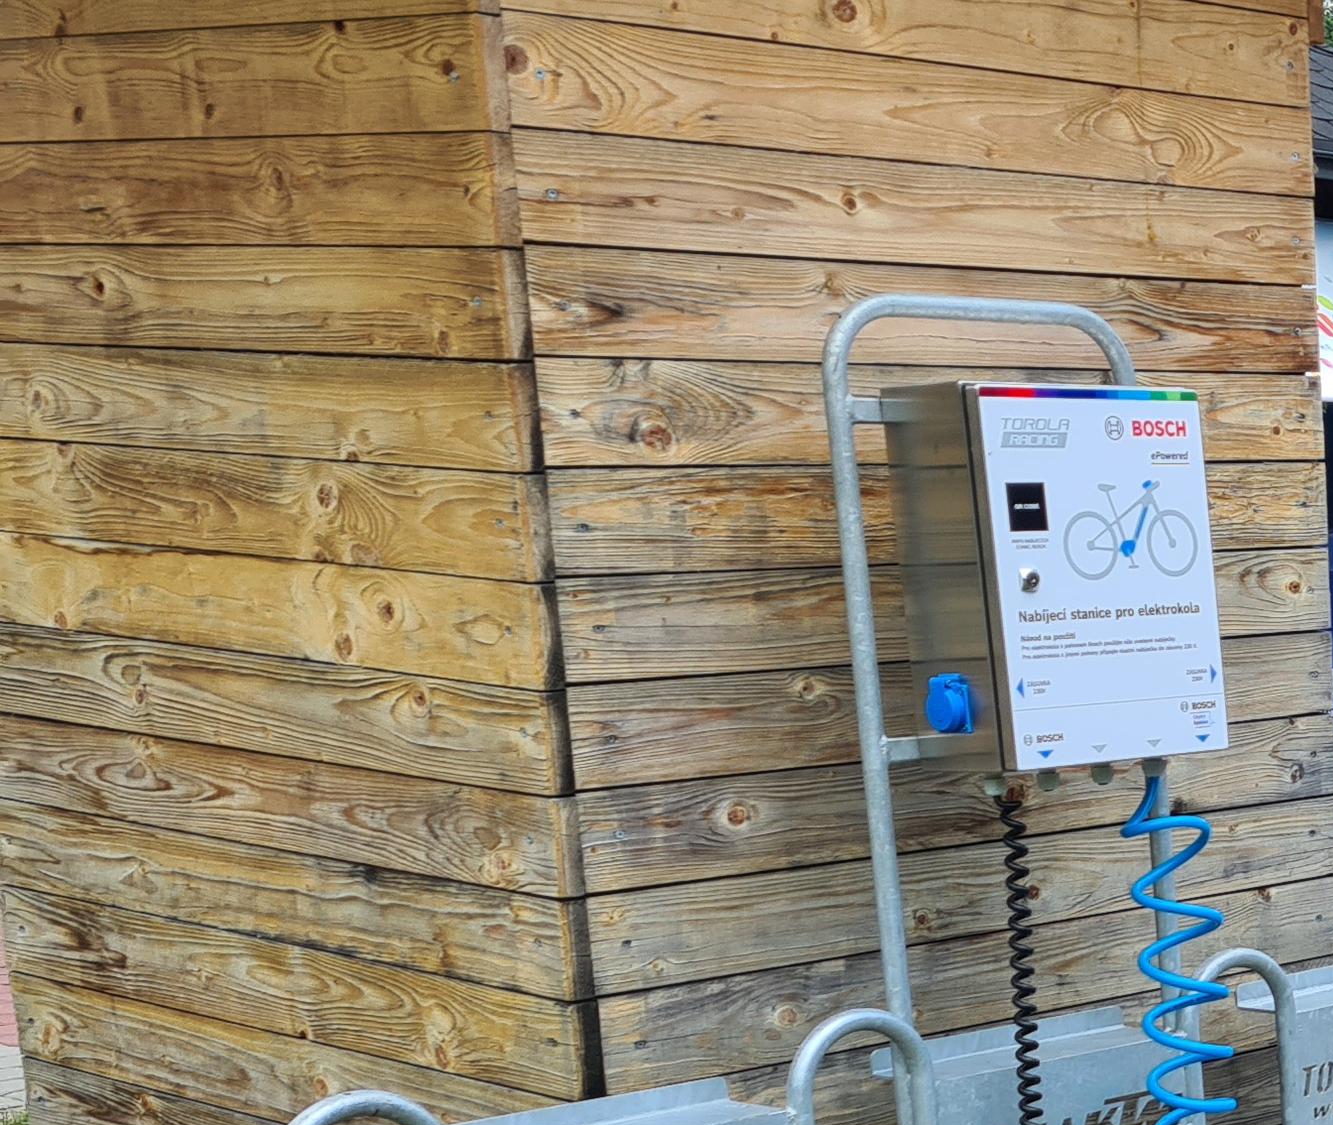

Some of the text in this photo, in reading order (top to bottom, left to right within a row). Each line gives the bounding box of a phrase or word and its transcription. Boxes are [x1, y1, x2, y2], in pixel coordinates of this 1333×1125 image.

[1000, 416, 1187, 437] TOROLA BOSCH
[1071, 606, 1112, 620] stanice
[1115, 607, 1135, 620] pro
[1137, 601, 1200, 616] elektrokola
[1036, 732, 1064, 743] BOSCH
